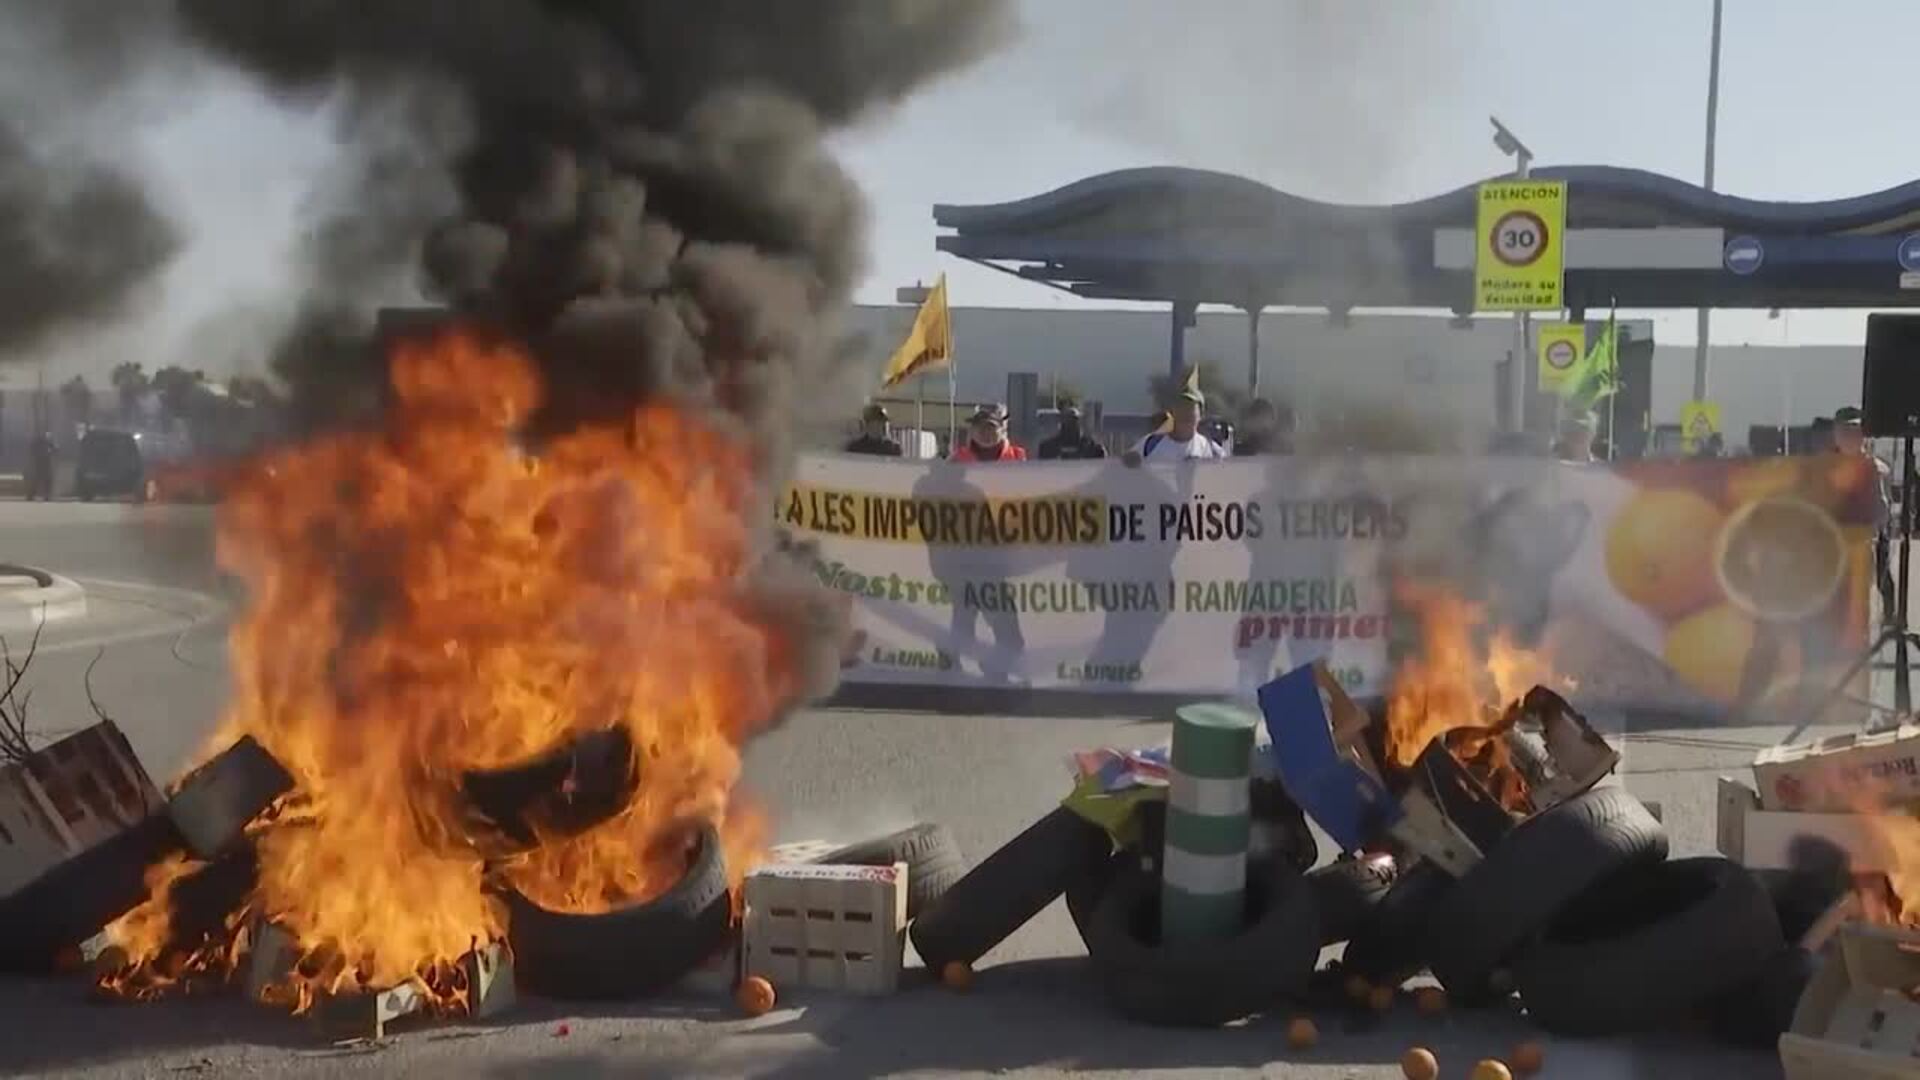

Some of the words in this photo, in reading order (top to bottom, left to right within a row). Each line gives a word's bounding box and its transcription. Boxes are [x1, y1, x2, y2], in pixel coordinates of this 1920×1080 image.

[1483, 187, 1559, 200] ATENCION
[1504, 229, 1535, 249] 30
[786, 487, 803, 526] A
[810, 490, 857, 536] LES
[863, 495, 1100, 544] IMPORTACIONS
[1109, 503, 1147, 541] DE
[1160, 493, 1264, 541] PAÏSOS
[1277, 500, 1411, 541] TERCERS
[962, 578, 1160, 615] AGRICULTURA
